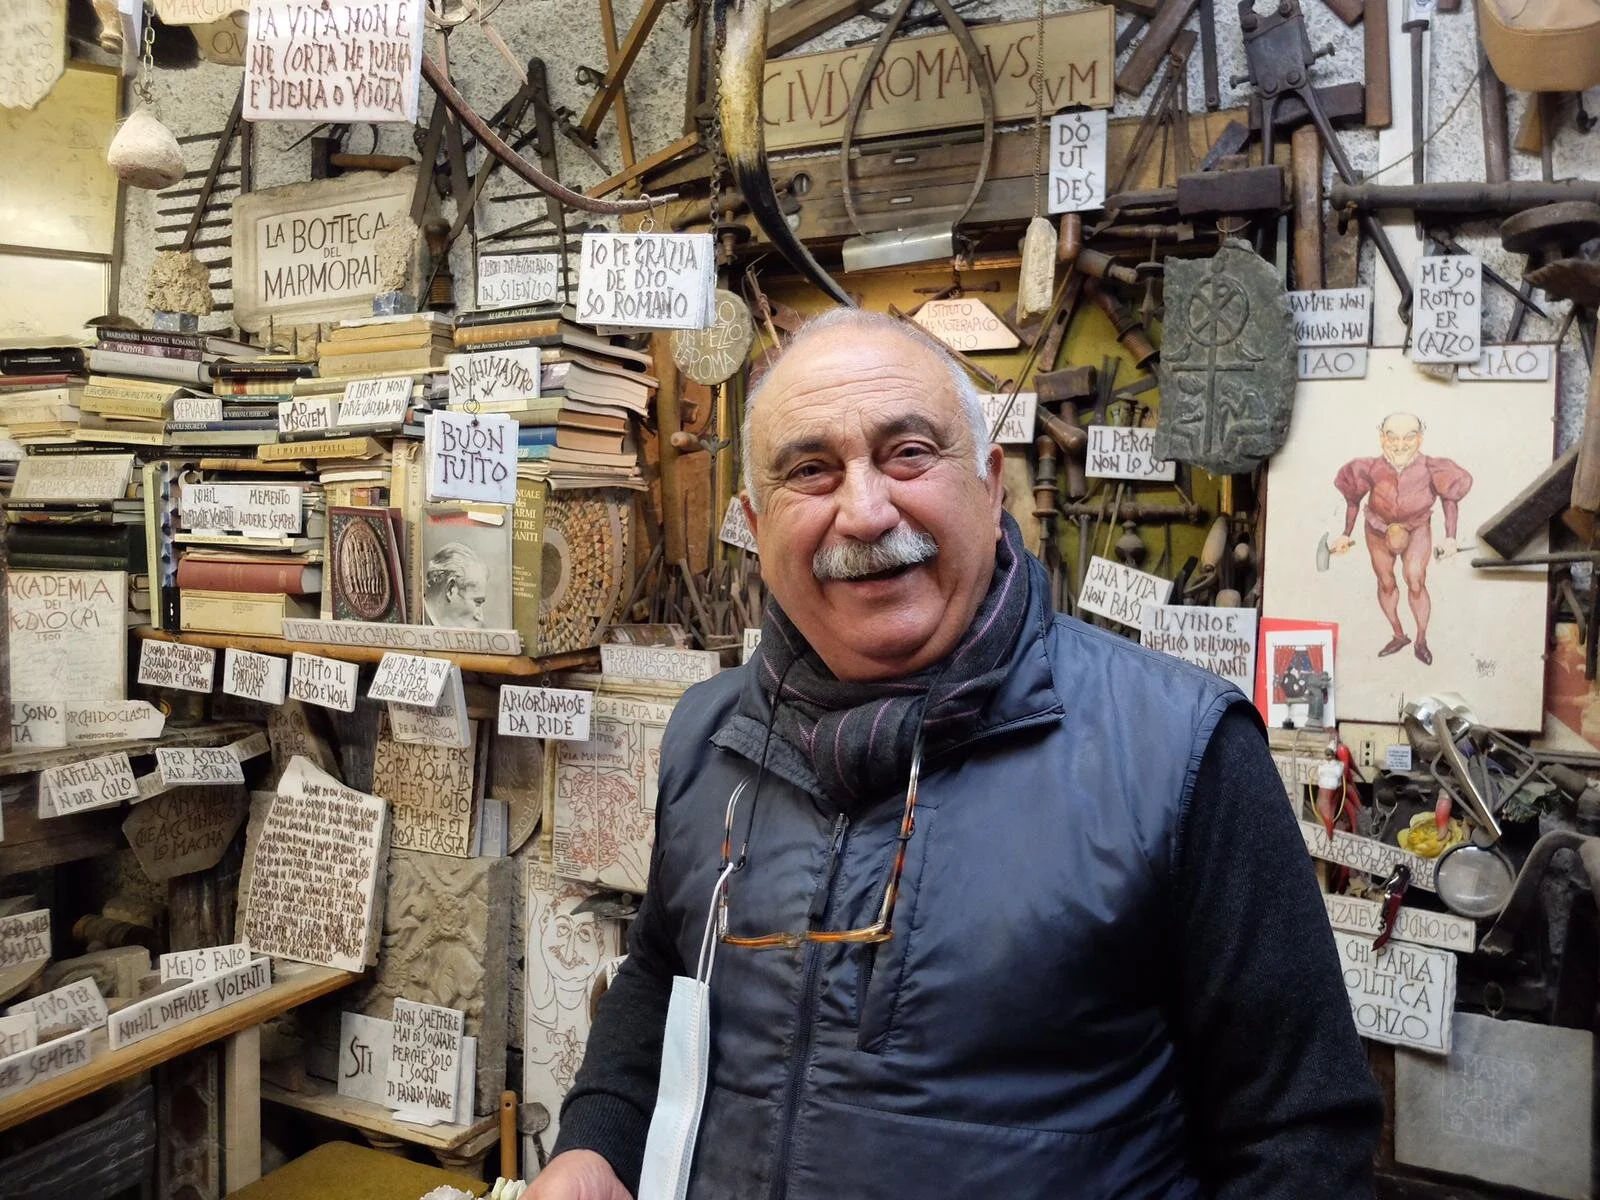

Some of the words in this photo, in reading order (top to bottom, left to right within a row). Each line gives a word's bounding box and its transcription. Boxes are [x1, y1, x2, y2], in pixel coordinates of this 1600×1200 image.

[256, 7, 278, 41] LA
[287, 4, 342, 42] VITA
[345, 4, 389, 38] NON
[284, 40, 338, 76] CORTA
[269, 75, 328, 111] PIENA
[761, 53, 858, 128] CIVIS
[1060, 123, 1090, 145] DO
[1060, 146, 1087, 169] UT
[1056, 172, 1095, 207] DES
[266, 223, 285, 248] LA
[323, 247, 341, 258] DEL
[613, 238, 630, 267] PE
[634, 238, 698, 275] GRAZIA
[496, 277, 553, 302] SILENZIO
[606, 268, 626, 292] DE
[634, 266, 667, 294] DIO
[580, 291, 605, 319] SO
[611, 285, 688, 321] ROMANO
[1420, 287, 1475, 310] ROTTO
[1436, 311, 1458, 330] ER
[700, 322, 743, 350] PEZZO
[1416, 330, 1475, 358] CAZZO
[687, 346, 737, 381] ROMA
[1304, 352, 1355, 375] IAO
[385, 379, 407, 394] NON
[290, 402, 308, 416] AD
[441, 420, 504, 454] BUON
[1092, 430, 1109, 454] IL
[437, 449, 508, 485] TUTTO
[1091, 456, 1120, 473] NON
[1126, 455, 1142, 474] LO
[1147, 454, 1166, 477] SO
[249, 488, 291, 506] MEMENTO
[1090, 563, 1118, 589] UNA
[1123, 568, 1157, 601] VITA
[1083, 585, 1107, 608] NON
[1154, 608, 1170, 631] IL
[1174, 610, 1223, 633] VINO
[295, 656, 332, 680] TUTTO
[335, 664, 346, 685] IL
[291, 676, 319, 700] RESTO
[509, 713, 529, 732] DA
[160, 750, 190, 766] PER
[192, 748, 238, 769] ASPERA
[374, 755, 412, 779] SORA
[168, 767, 185, 780] AD
[190, 765, 234, 781] ASTRA
[72, 787, 97, 805] DER
[1345, 939, 1369, 963] CHI
[1374, 944, 1434, 984] PARLA
[214, 963, 265, 1002] VOLENTI
[1343, 967, 1432, 1014] OLITICA
[395, 1007, 416, 1028] NON
[344, 1036, 374, 1078] STI
